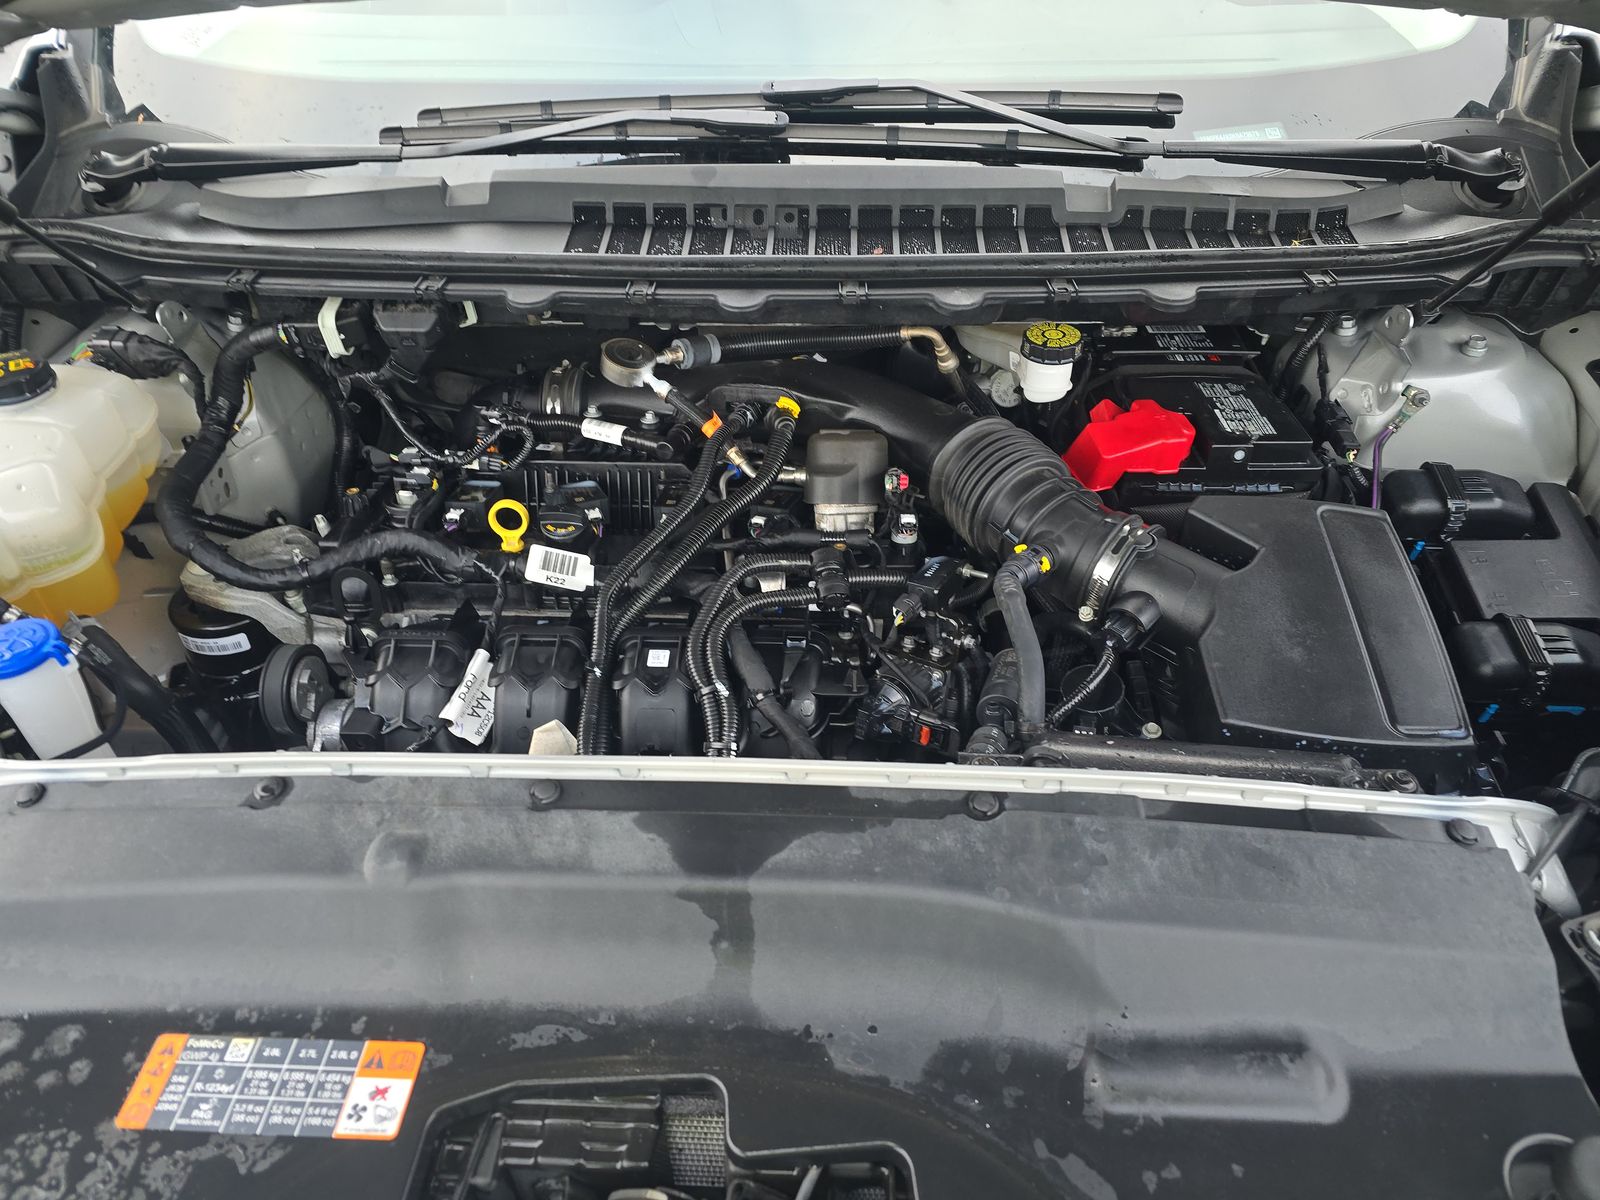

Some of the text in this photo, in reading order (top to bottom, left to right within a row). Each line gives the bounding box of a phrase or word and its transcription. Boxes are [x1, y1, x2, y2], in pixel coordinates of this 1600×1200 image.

[545, 574, 566, 586] K22
[458, 672, 478, 703] Ford
[467, 690, 492, 719] AAA
[187, 1038, 225, 1049] FoMoCo
[194, 1082, 235, 1093] R-1234yf
